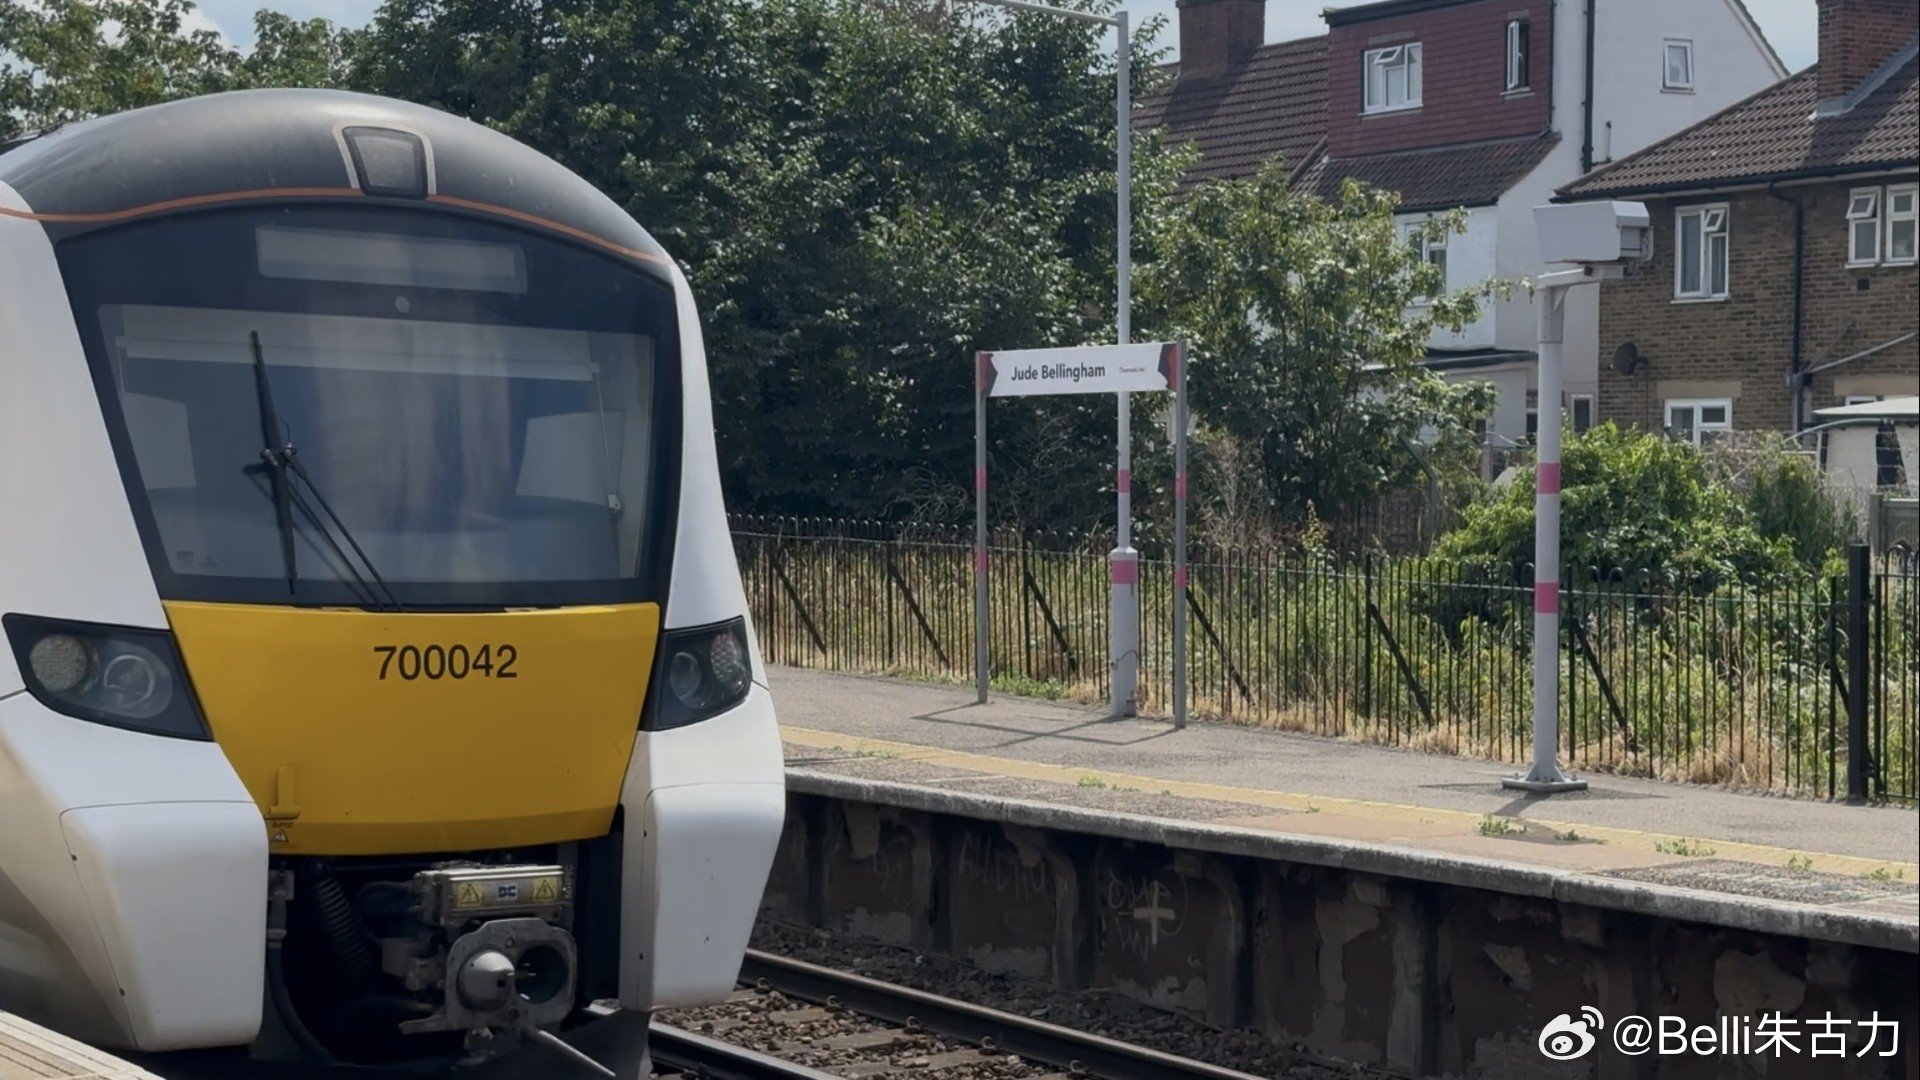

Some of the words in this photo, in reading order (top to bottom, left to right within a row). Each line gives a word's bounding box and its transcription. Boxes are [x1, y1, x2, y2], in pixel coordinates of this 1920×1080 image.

[1011, 365, 1038, 381] Jude
[1041, 362, 1106, 382] Bellingham
[373, 643, 518, 681] 700042
